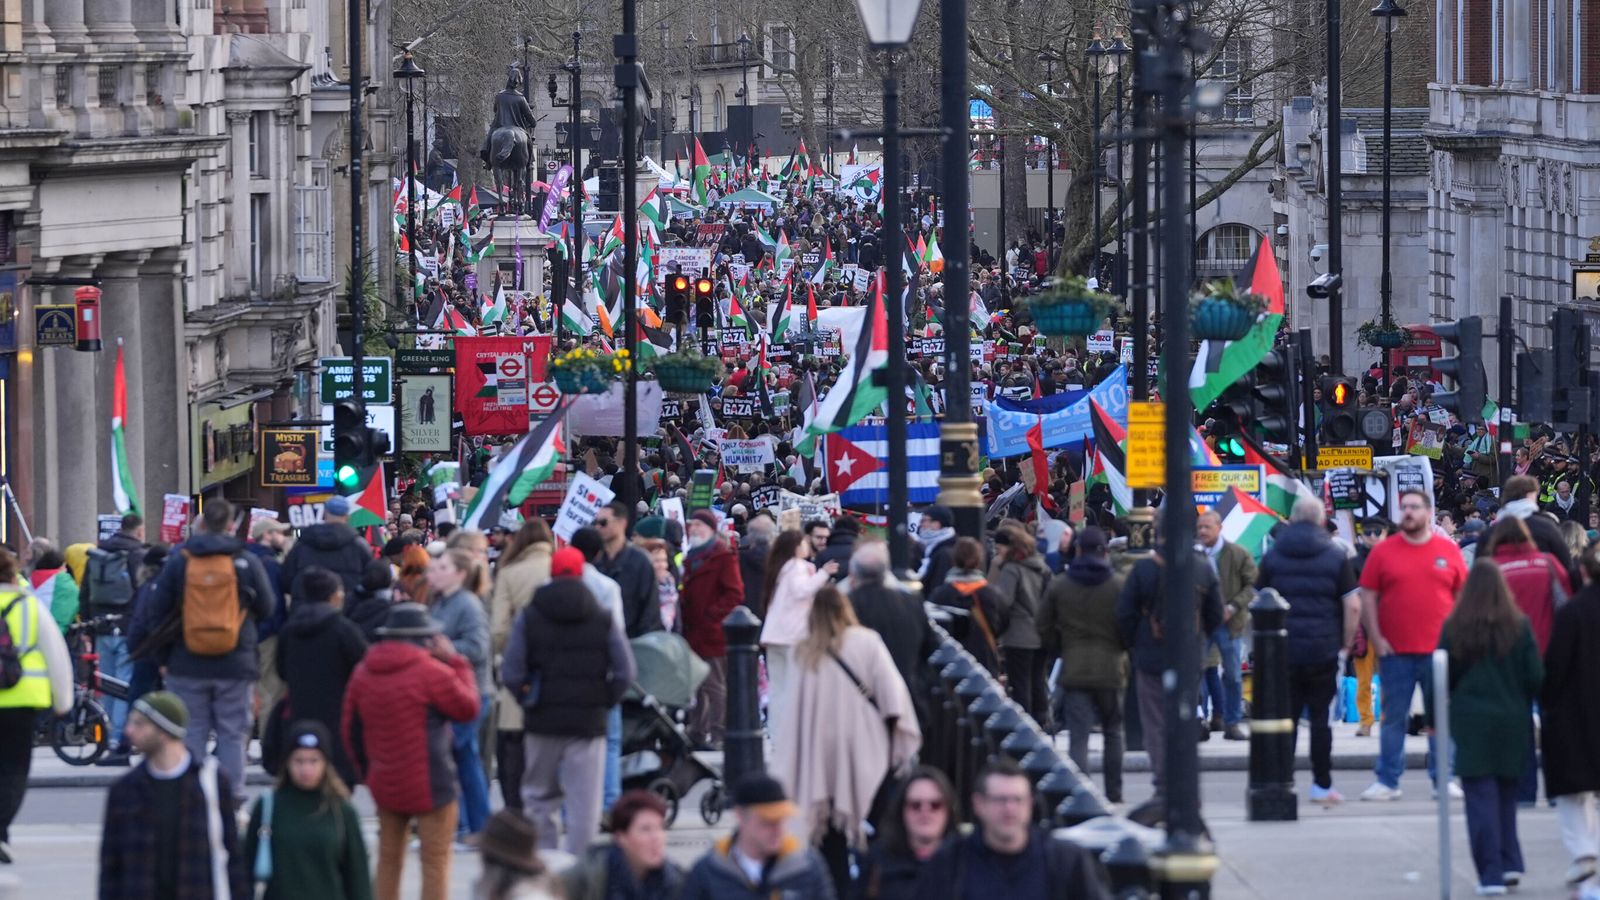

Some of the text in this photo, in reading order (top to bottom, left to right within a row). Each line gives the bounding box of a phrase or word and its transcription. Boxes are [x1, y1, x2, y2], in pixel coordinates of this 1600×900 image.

[723, 333, 746, 343] GAZA
[523, 342, 534, 352] M
[328, 366, 382, 374] AMECAN
[661, 405, 679, 416] ZA
[723, 404, 752, 416] GAZA
[275, 433, 305, 442] MYSTIC
[721, 442, 736, 451] ONLY
[725, 455, 763, 464] HUMANITY
[270, 472, 310, 482] TREASURES
[1195, 472, 1254, 481] FREE QUR'AN
[1194, 494, 1214, 502] TAKE
[288, 503, 325, 527] GAZ
[566, 507, 589, 525] Isra
